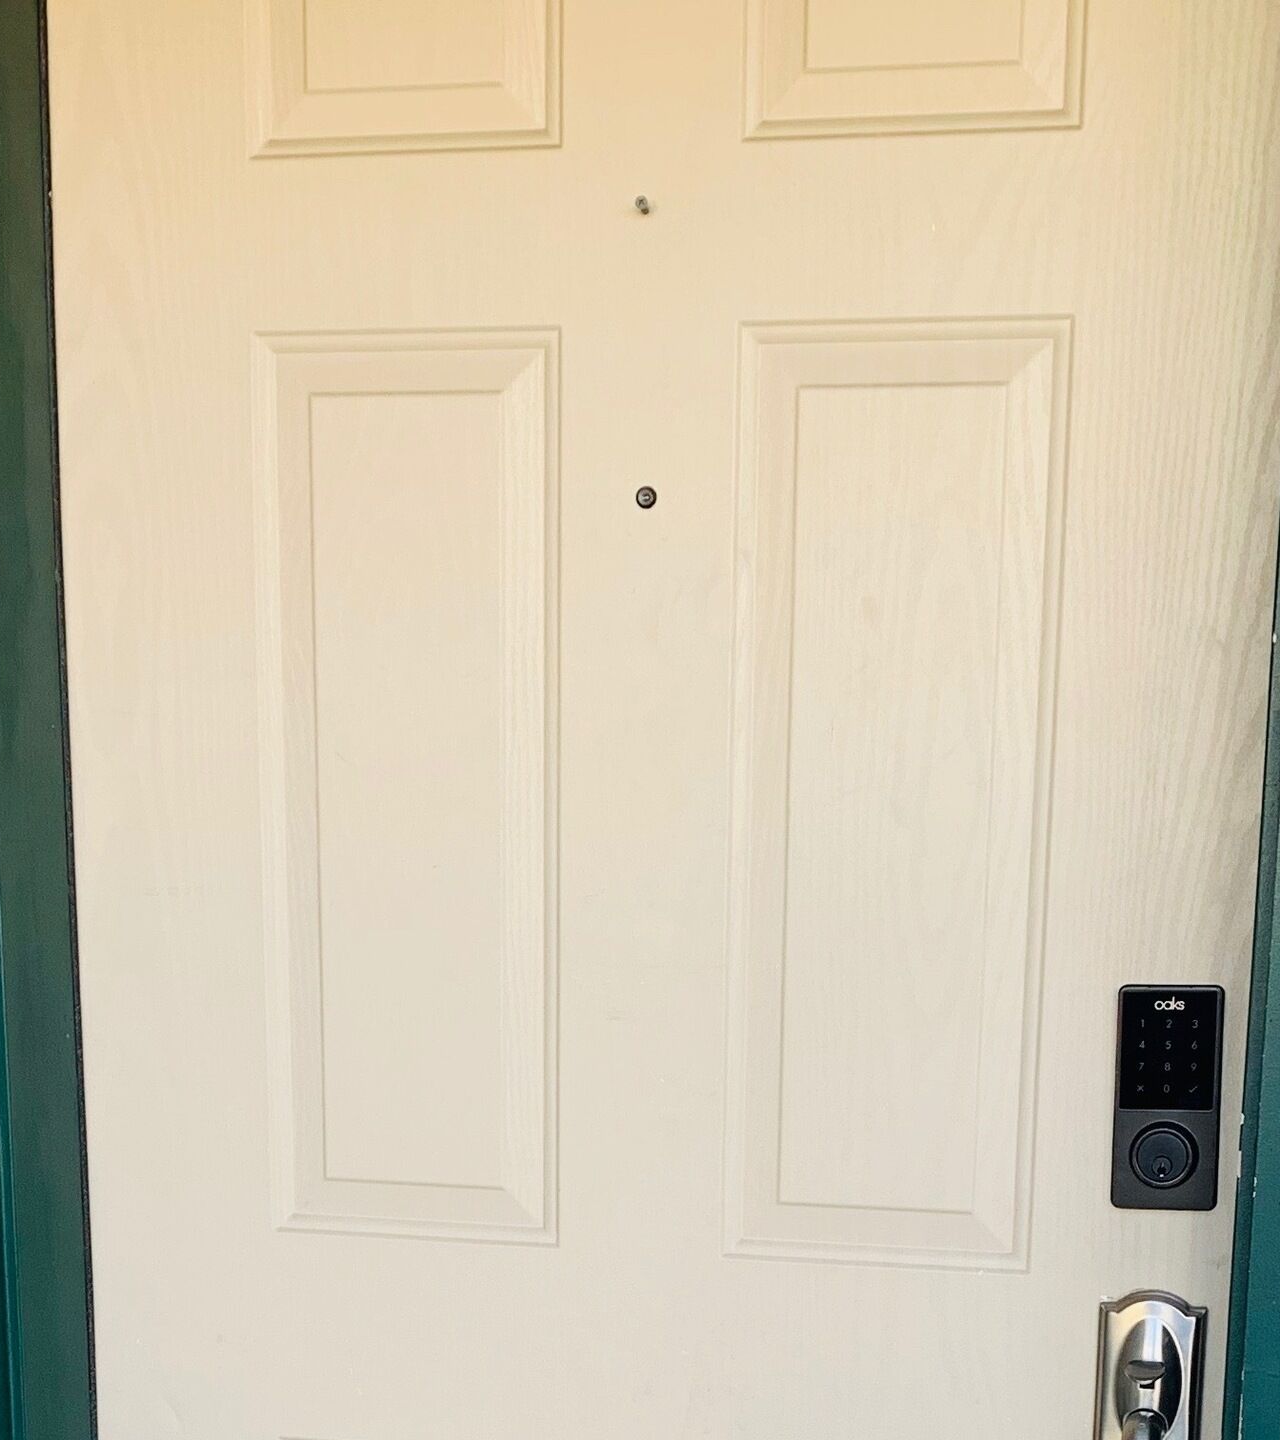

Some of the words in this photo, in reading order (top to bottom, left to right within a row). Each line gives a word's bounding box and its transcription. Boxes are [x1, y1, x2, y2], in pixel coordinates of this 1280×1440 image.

[1154, 996, 1185, 1011] oaks
[1165, 1019, 1173, 1029] 2
[1191, 1019, 1199, 1029] 3
[1138, 1040, 1145, 1049] 4
[1165, 1040, 1172, 1050] 5
[1191, 1040, 1198, 1050] 6
[1164, 1062, 1171, 1072] 8
[1190, 1062, 1197, 1072] 9
[1163, 1084, 1170, 1094] 0
